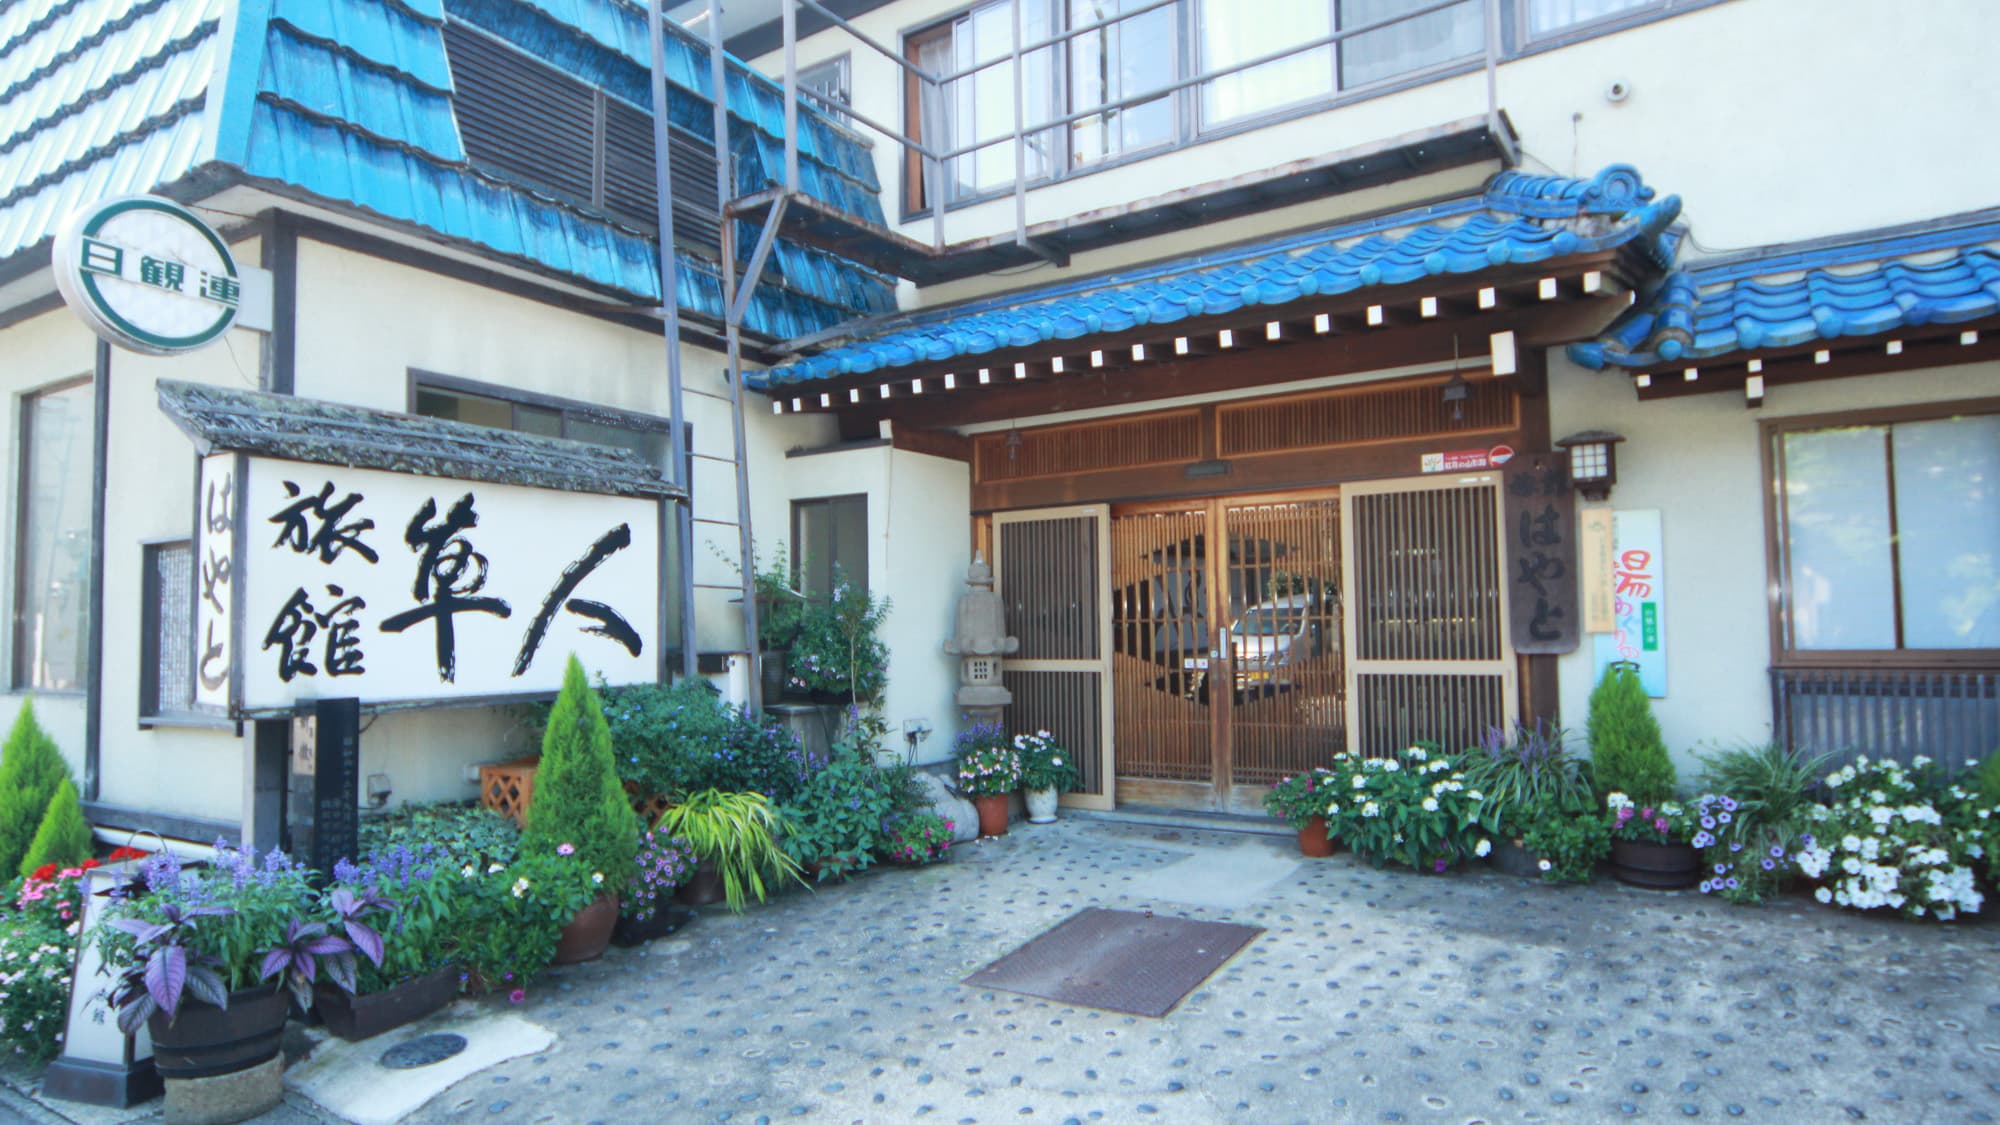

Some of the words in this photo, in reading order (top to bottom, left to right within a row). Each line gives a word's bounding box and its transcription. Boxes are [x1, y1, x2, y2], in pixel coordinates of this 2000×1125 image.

[81, 237, 240, 307] 日観連
[199, 472, 231, 691] はやと
[262, 480, 380, 683] 旅館
[379, 491, 643, 685] 隼人
[1517, 504, 1566, 642] はやと
